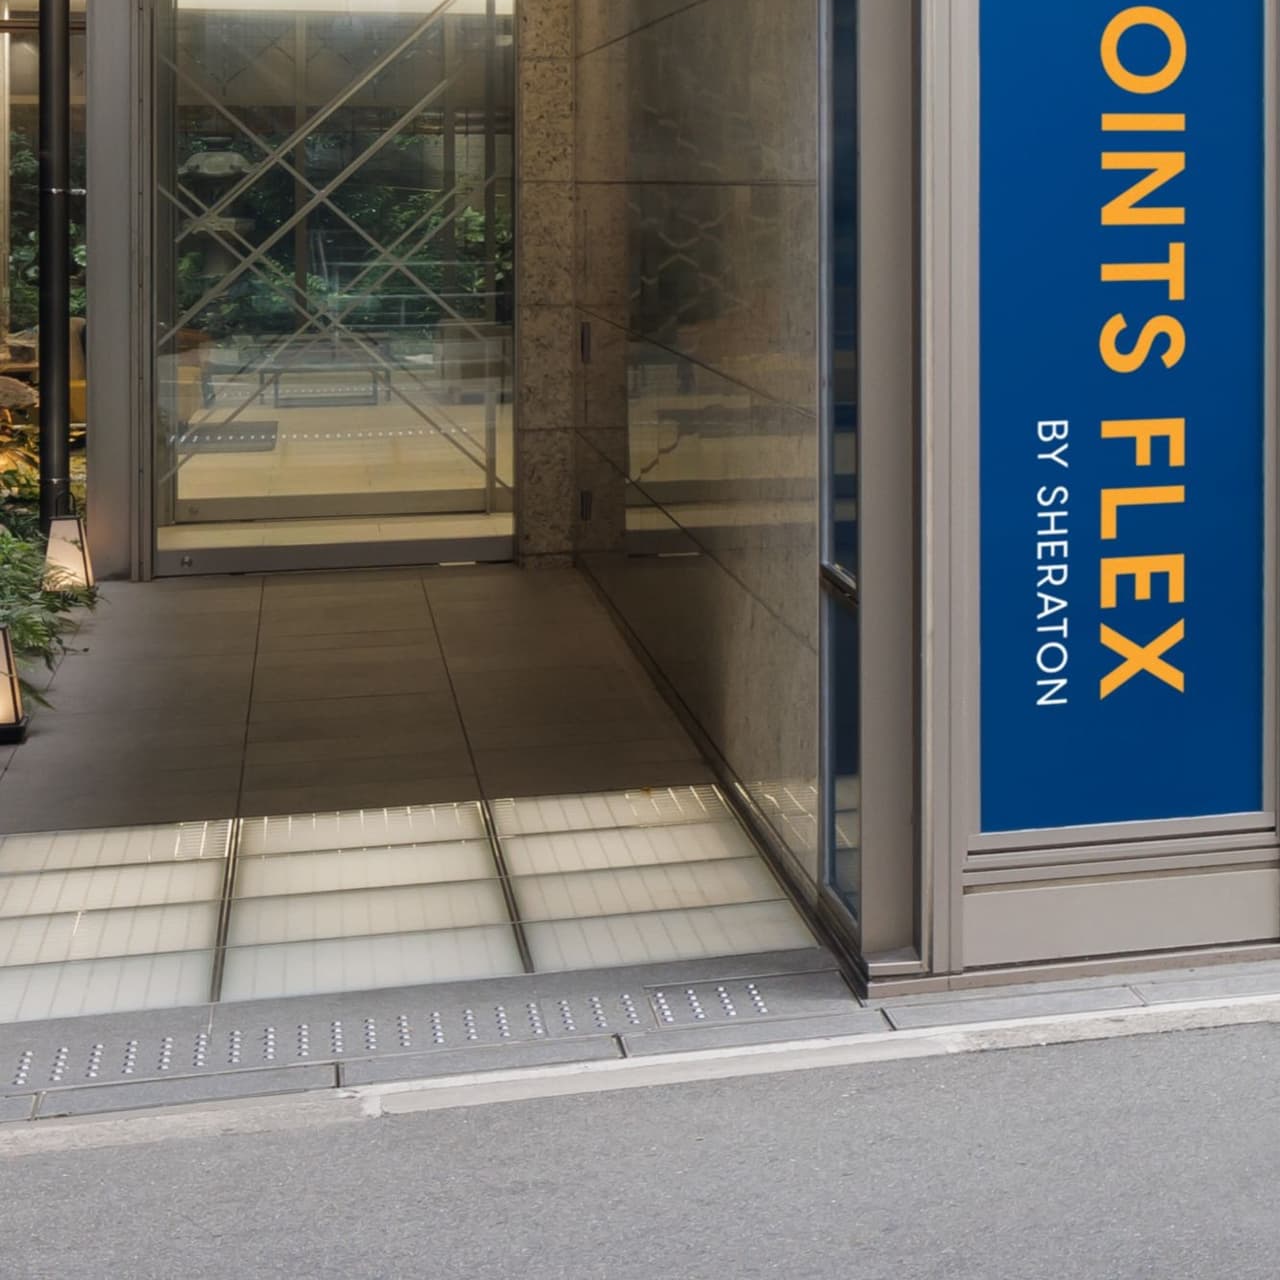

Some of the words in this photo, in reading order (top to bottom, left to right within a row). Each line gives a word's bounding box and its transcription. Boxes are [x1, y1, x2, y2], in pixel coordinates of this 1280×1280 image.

[1036, 419, 1069, 467] BY
[1036, 486, 1069, 707] SHERATON
[1100, 417, 1185, 699] FLEX
